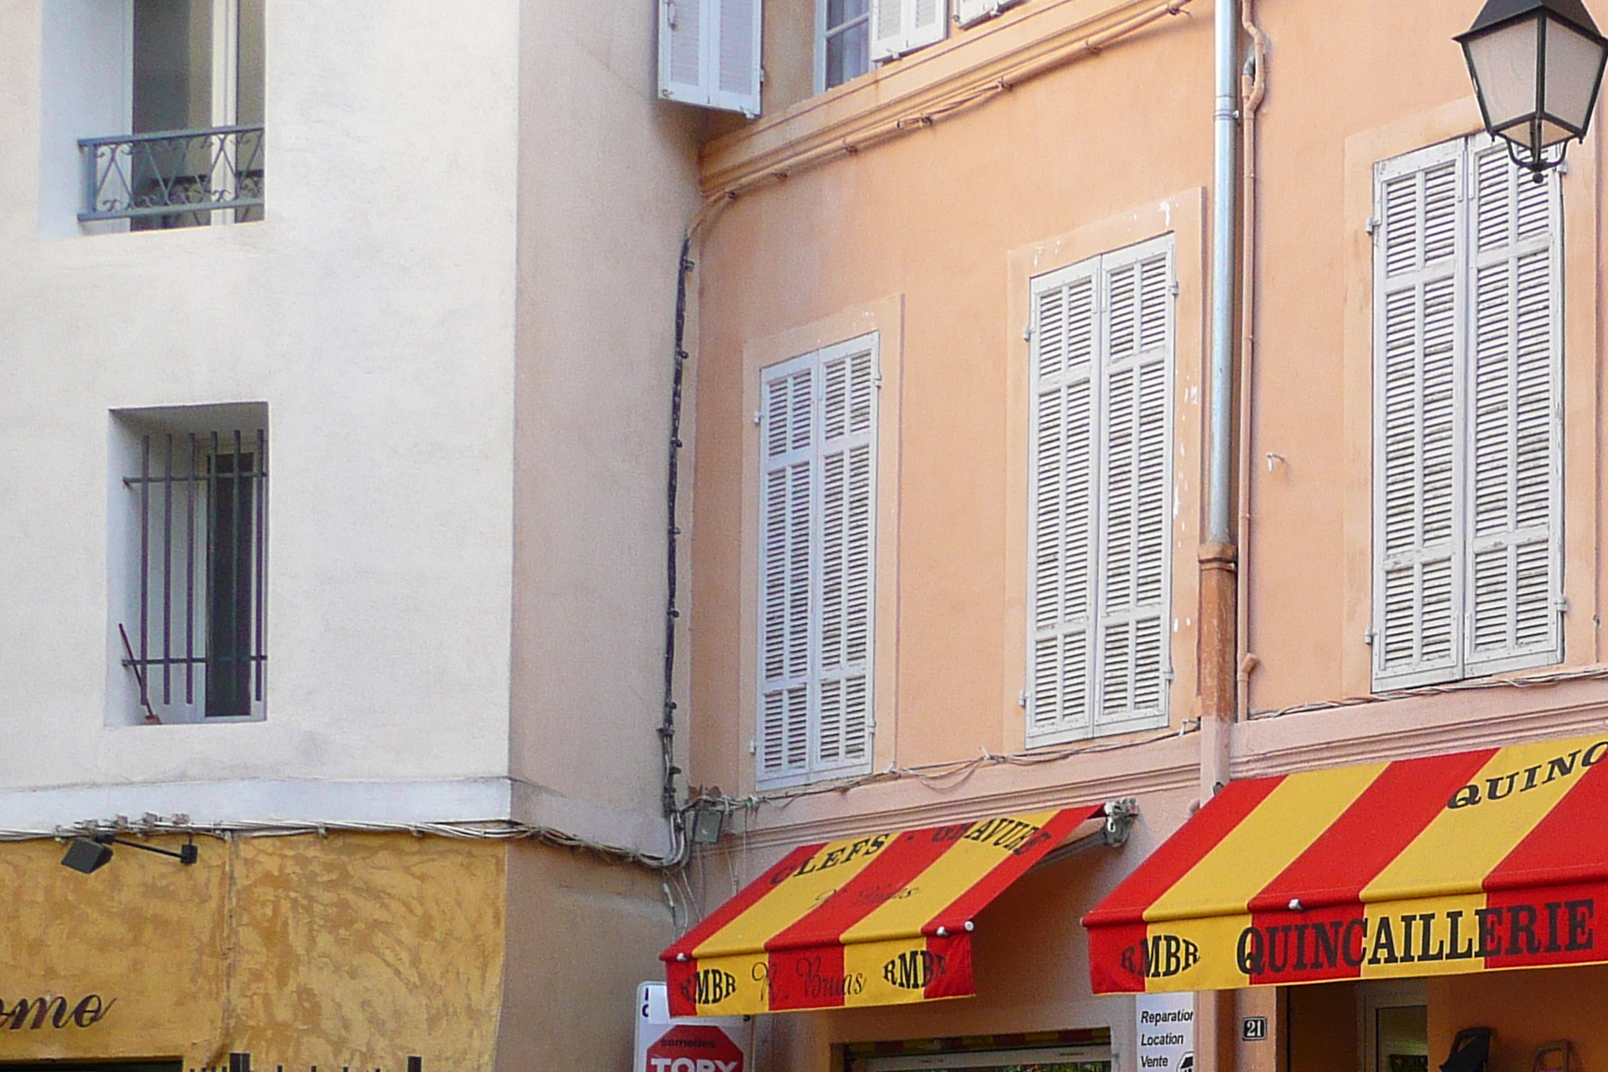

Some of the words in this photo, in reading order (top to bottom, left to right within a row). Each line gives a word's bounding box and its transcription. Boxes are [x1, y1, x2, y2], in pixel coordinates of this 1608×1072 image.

[769, 832, 891, 886] CLEFS
[1236, 897, 1595, 976] QUINCAILLERIE
[1120, 933, 1201, 979] RMBR
[1140, 1032, 1184, 1047] Location
[1246, 1020, 1262, 1037] 21
[1140, 1055, 1169, 1068] Vente
